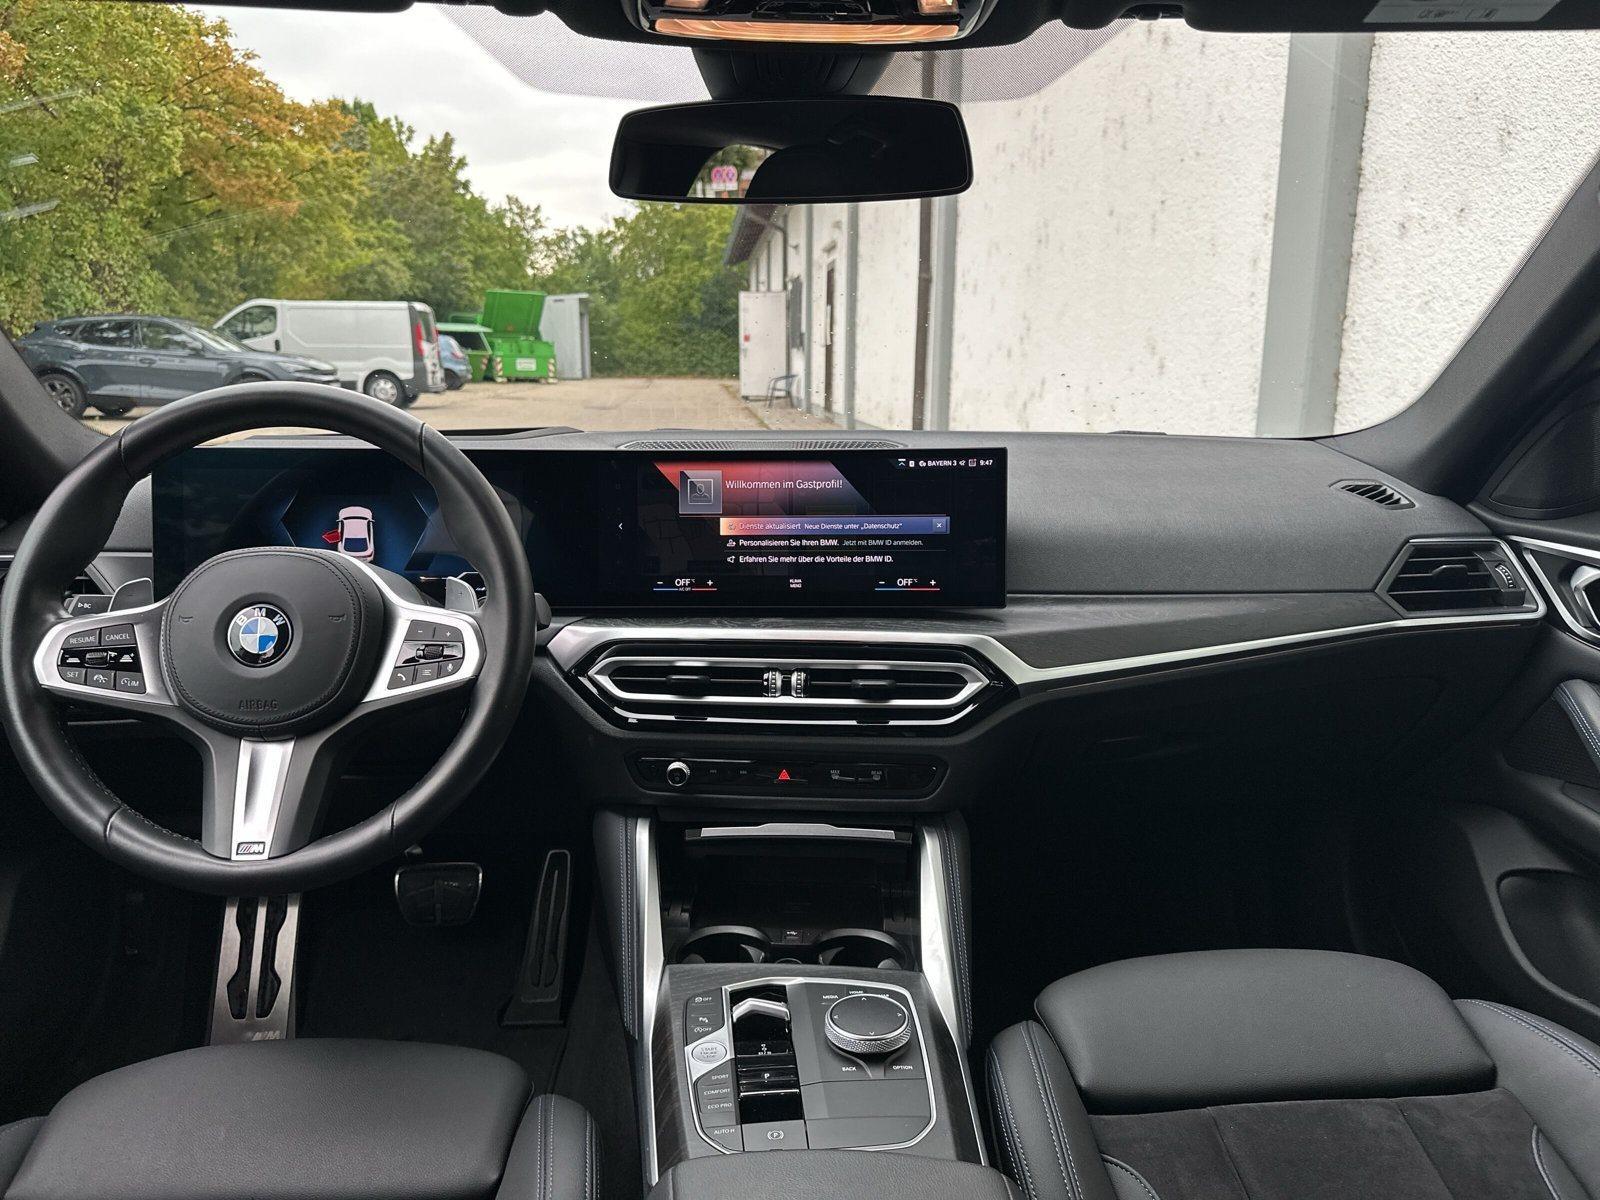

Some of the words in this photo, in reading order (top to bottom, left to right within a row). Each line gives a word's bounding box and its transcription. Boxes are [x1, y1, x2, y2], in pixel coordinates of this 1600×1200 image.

[725, 480, 781, 489] Willkommen
[782, 480, 794, 489] im
[796, 479, 843, 490] Gastprofil!
[740, 522, 764, 530] Dienste
[765, 522, 801, 530] aktualisiert
[674, 578, 690, 586] OFF
[896, 578, 912, 586] OFF
[236, 608, 286, 626] BMW
[69, 636, 96, 644] RESUME
[105, 633, 130, 641] CANCEL
[239, 700, 278, 710] AIRBAG
